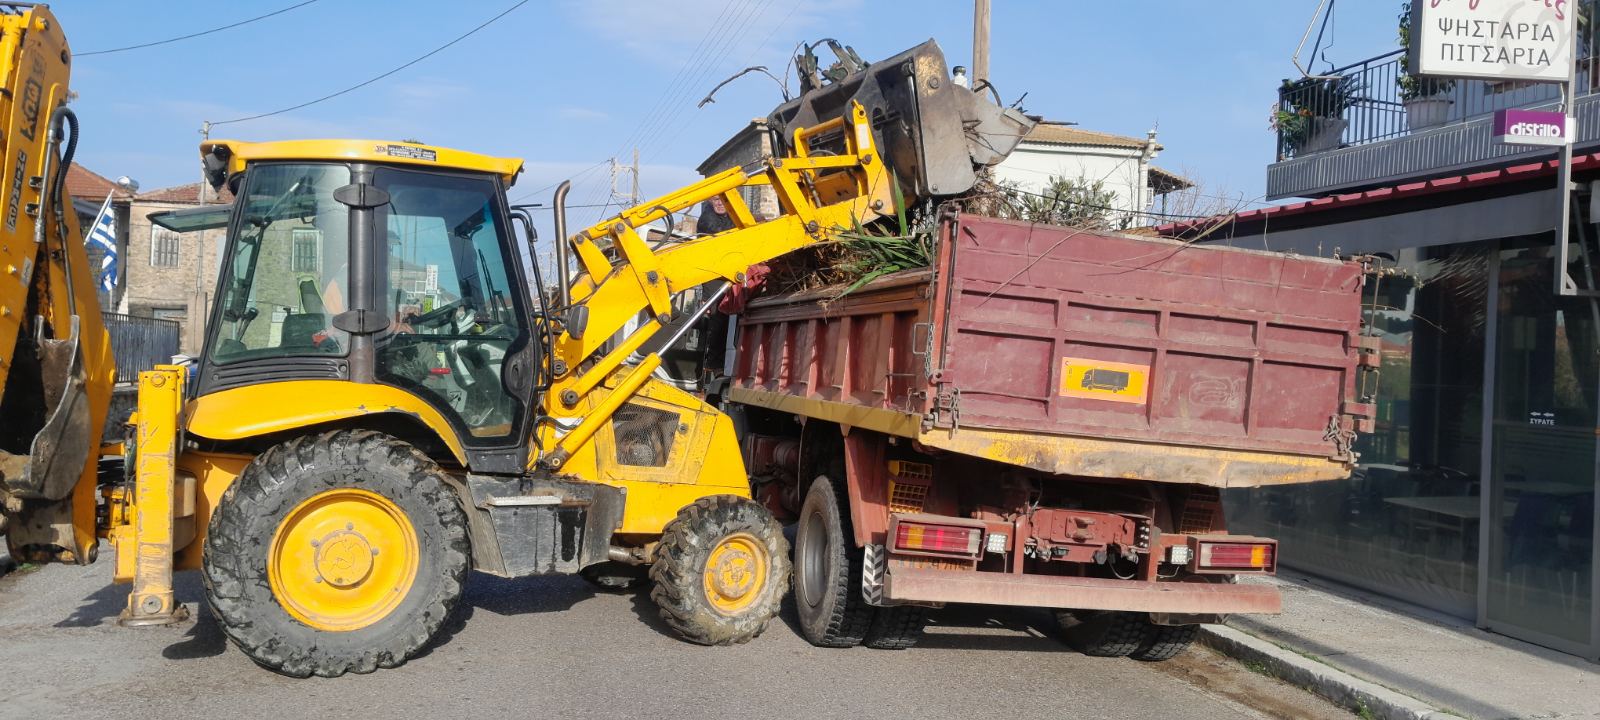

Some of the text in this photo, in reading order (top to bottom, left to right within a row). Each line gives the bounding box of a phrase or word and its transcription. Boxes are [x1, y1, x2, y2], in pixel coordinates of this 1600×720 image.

[1438, 17, 1555, 42] ΨΗΣΤΑΡΙΑ
[1441, 43, 1551, 66] ΠΙΤΣΑΡΙΑ
[1509, 122, 1561, 138] distillo
[1529, 418, 1555, 426] ΣΥΡΑΤΕ
